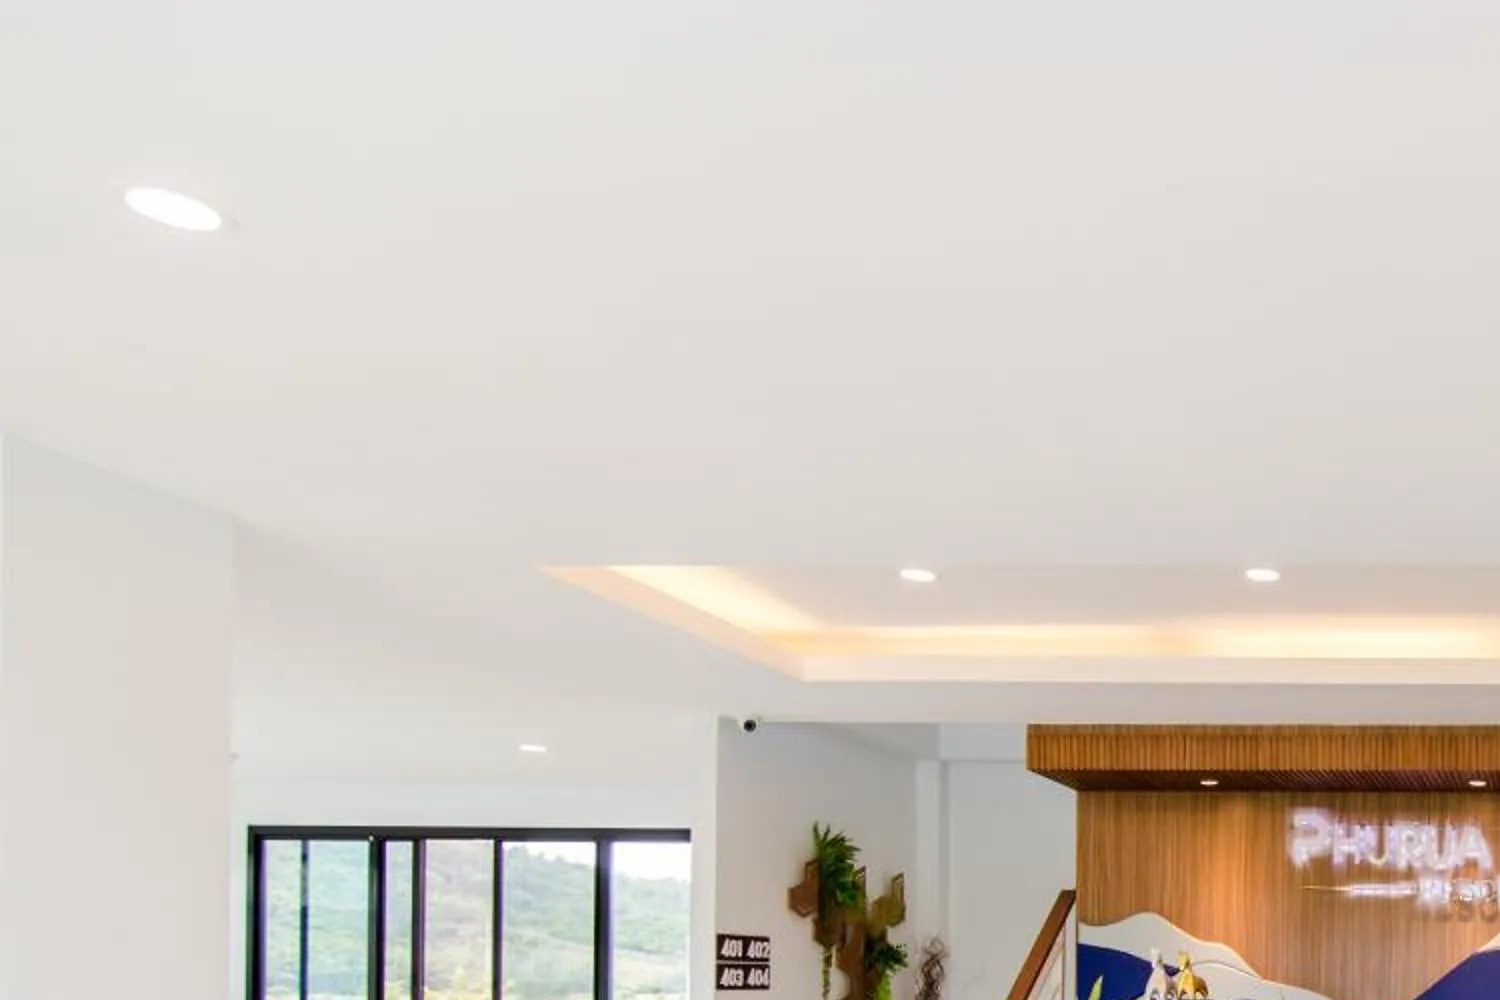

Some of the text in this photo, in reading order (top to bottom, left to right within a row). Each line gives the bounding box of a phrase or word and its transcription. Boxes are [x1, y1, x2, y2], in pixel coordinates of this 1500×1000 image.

[1289, 808, 1494, 868] PHURUA
[721, 939, 769, 958] 401 402
[720, 967, 769, 987] 403 404
